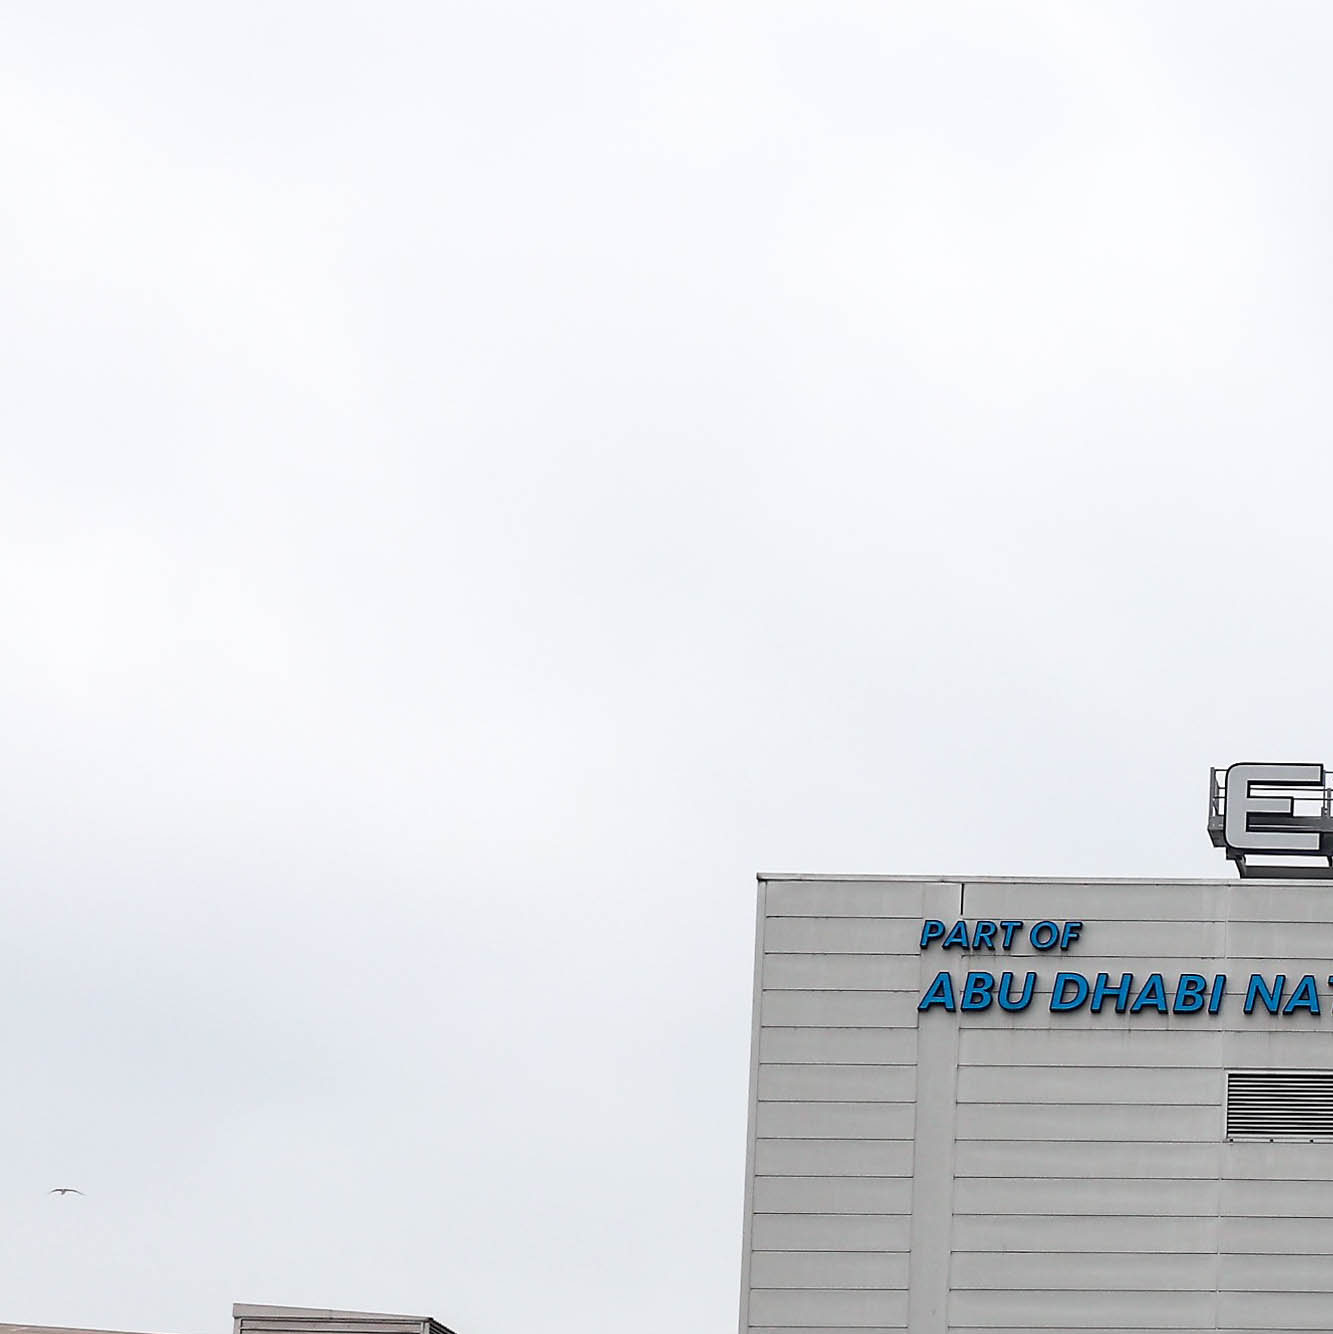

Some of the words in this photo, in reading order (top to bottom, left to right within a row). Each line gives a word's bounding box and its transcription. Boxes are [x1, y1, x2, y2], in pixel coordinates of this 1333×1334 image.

[920, 919, 1022, 951] PART
[1029, 920, 1082, 950] OF
[918, 971, 1036, 1012] ABU
[1050, 972, 1226, 1014] DHABI
